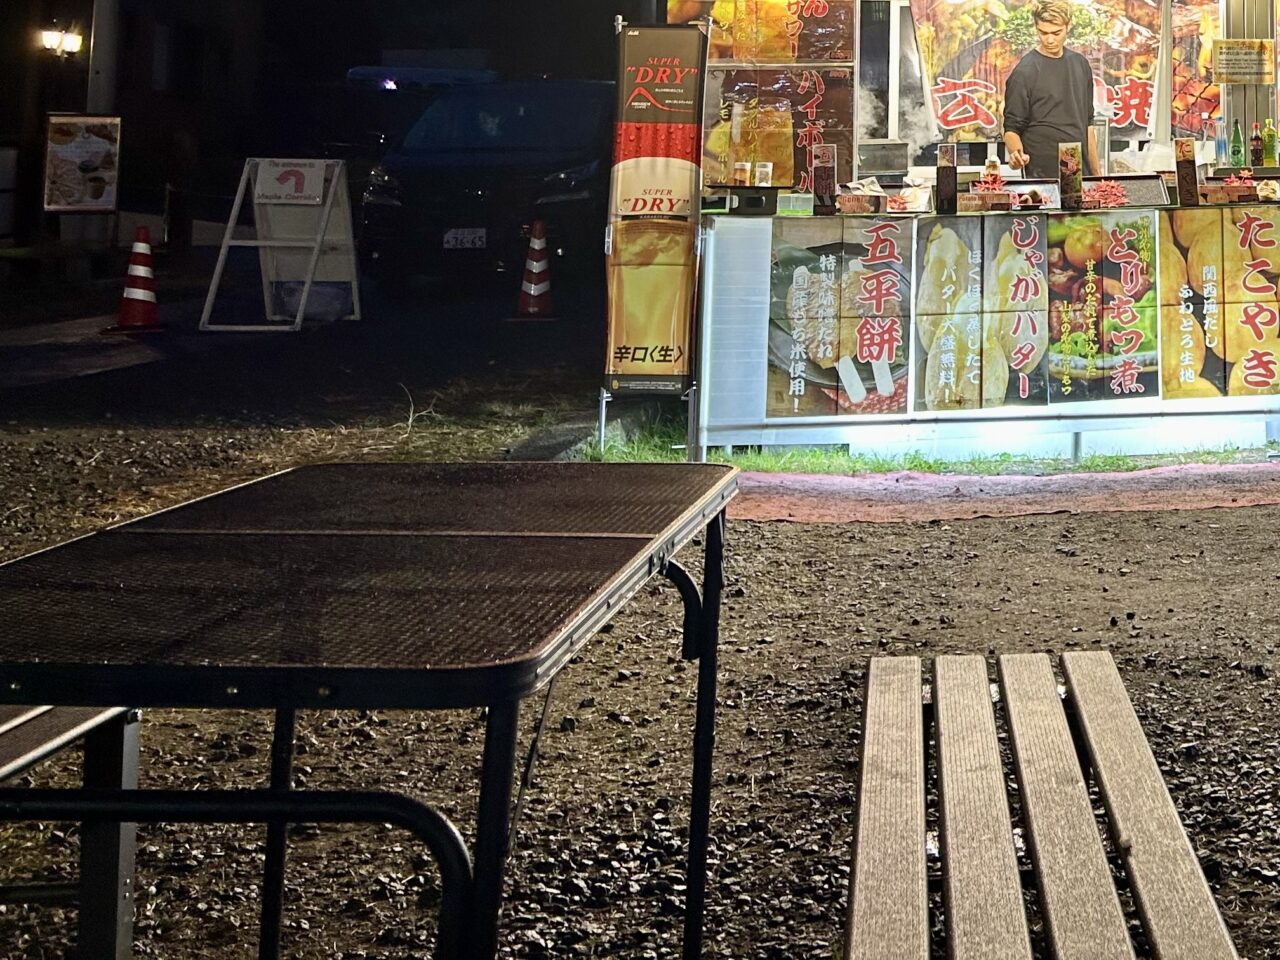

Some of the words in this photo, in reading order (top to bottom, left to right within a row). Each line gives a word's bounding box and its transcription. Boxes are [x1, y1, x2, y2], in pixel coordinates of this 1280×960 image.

[648, 57, 680, 65] SUPER
[642, 188, 672, 196] SUPER
[796, 70, 825, 192] ハイボール
[787, 265, 810, 413] 国産もち米使用!
[856, 222, 903, 363] 五平餅
[940, 265, 957, 403] バター大盛無料!
[966, 250, 983, 385] ほくほく蒸したて
[1009, 215, 1045, 399] じゃがバター
[1107, 227, 1145, 395] とりもつ煮
[1178, 286, 1195, 383] ふわとろ生地
[1203, 265, 1218, 348] 関西風だし
[1236, 211, 1280, 388] たこやき
